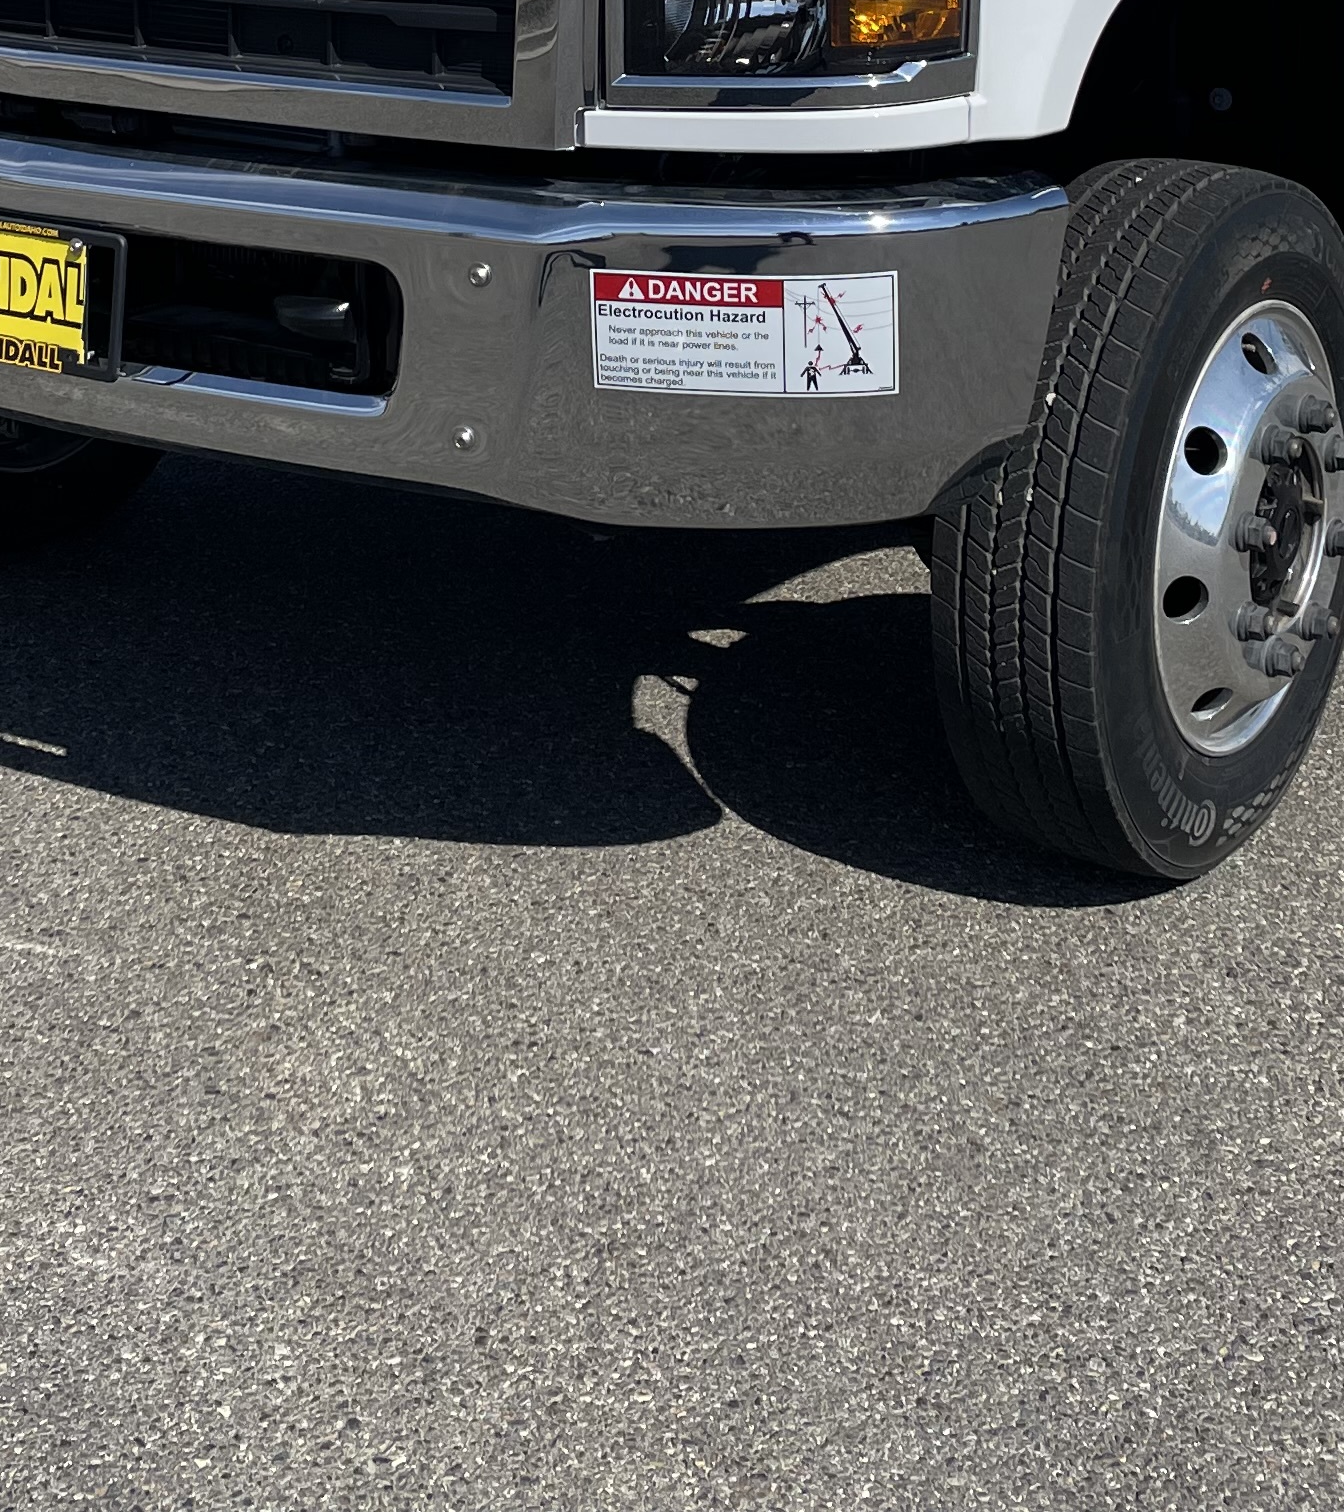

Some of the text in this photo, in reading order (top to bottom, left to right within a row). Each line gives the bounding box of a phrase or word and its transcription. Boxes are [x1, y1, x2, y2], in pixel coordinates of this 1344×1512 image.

[648, 279, 758, 303] DANGER
[598, 304, 766, 324] Electrocution Hazard
[608, 325, 636, 335] Never
[639, 327, 683, 339] approach
[686, 329, 703, 338] this
[705, 330, 739, 340] vehicle
[754, 331, 769, 340] the
[608, 336, 739, 351] load if it is near power lines.
[600, 354, 775, 370] Death or serious injury will result from
[600, 364, 640, 375] touching
[654, 367, 680, 378] being
[683, 369, 704, 378] near
[707, 369, 723, 378] this
[726, 370, 760, 380] vehicle
[600, 373, 686, 388] becomes charged.
[1131, 703, 1217, 847] Continenta
